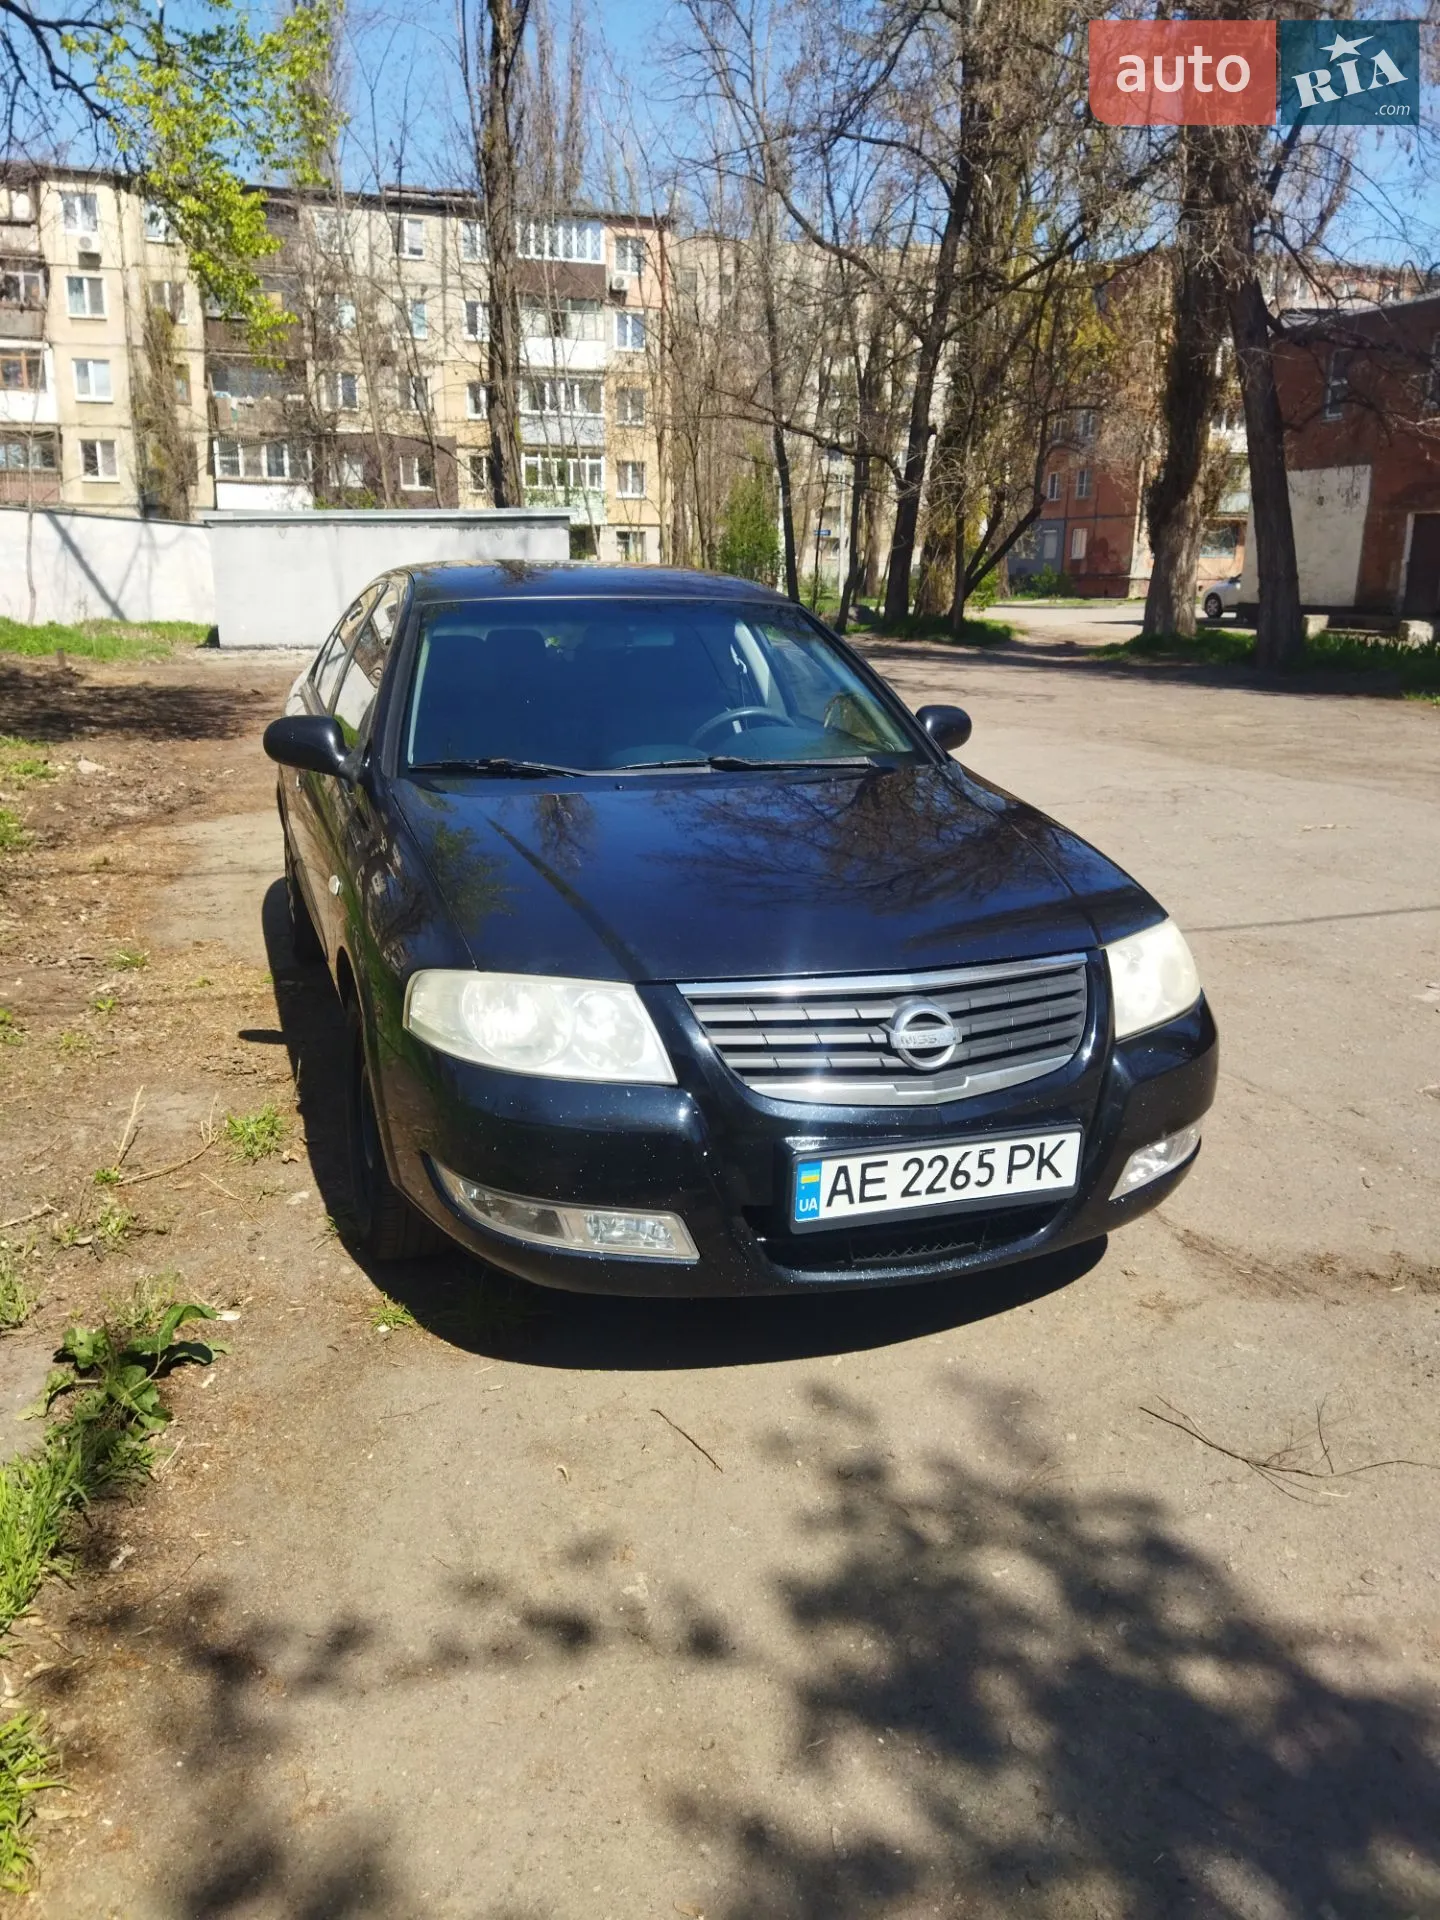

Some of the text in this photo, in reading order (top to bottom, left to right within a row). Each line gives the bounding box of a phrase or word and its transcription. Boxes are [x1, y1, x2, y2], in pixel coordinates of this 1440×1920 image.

[826, 1139, 1066, 1207] AE 2265 PK
[799, 1197, 818, 1213] UA
